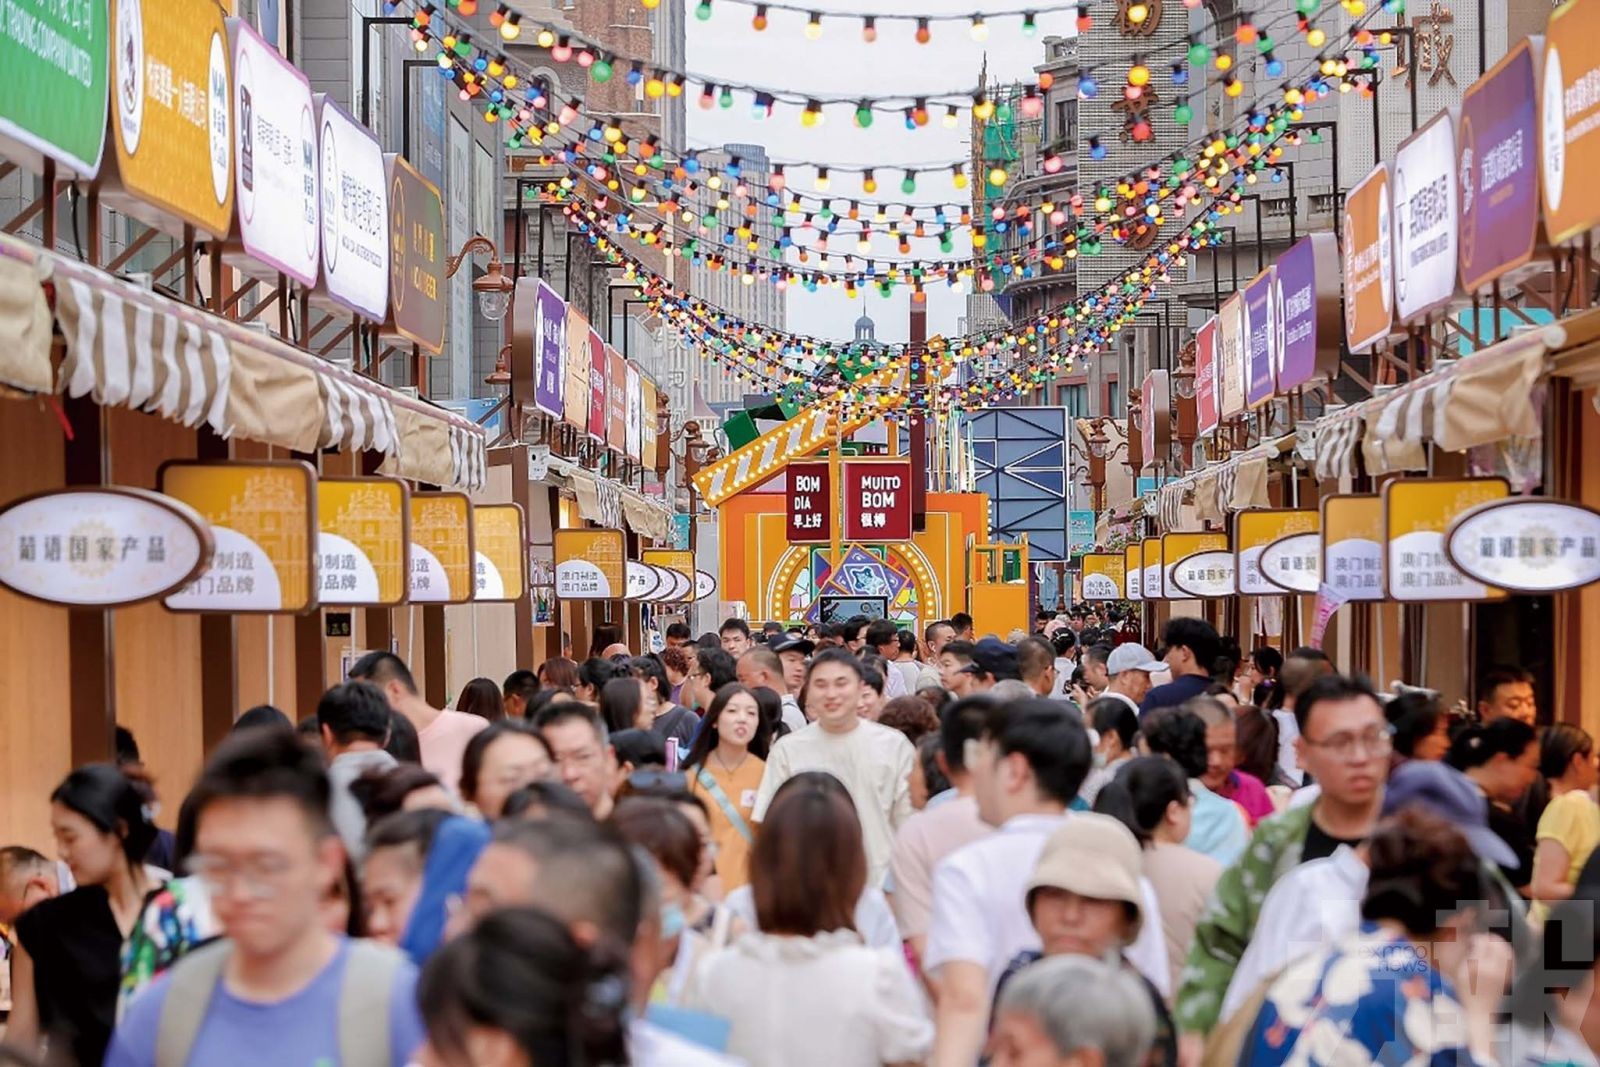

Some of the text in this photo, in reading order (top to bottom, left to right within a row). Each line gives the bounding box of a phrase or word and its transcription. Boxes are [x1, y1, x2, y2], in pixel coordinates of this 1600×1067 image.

[795, 475, 820, 492] BOM
[861, 476, 901, 490] MUITO
[794, 496, 811, 510] DIA
[862, 492, 895, 508] BOM
[793, 513, 822, 528] 早上好
[861, 512, 886, 527] 很棒
